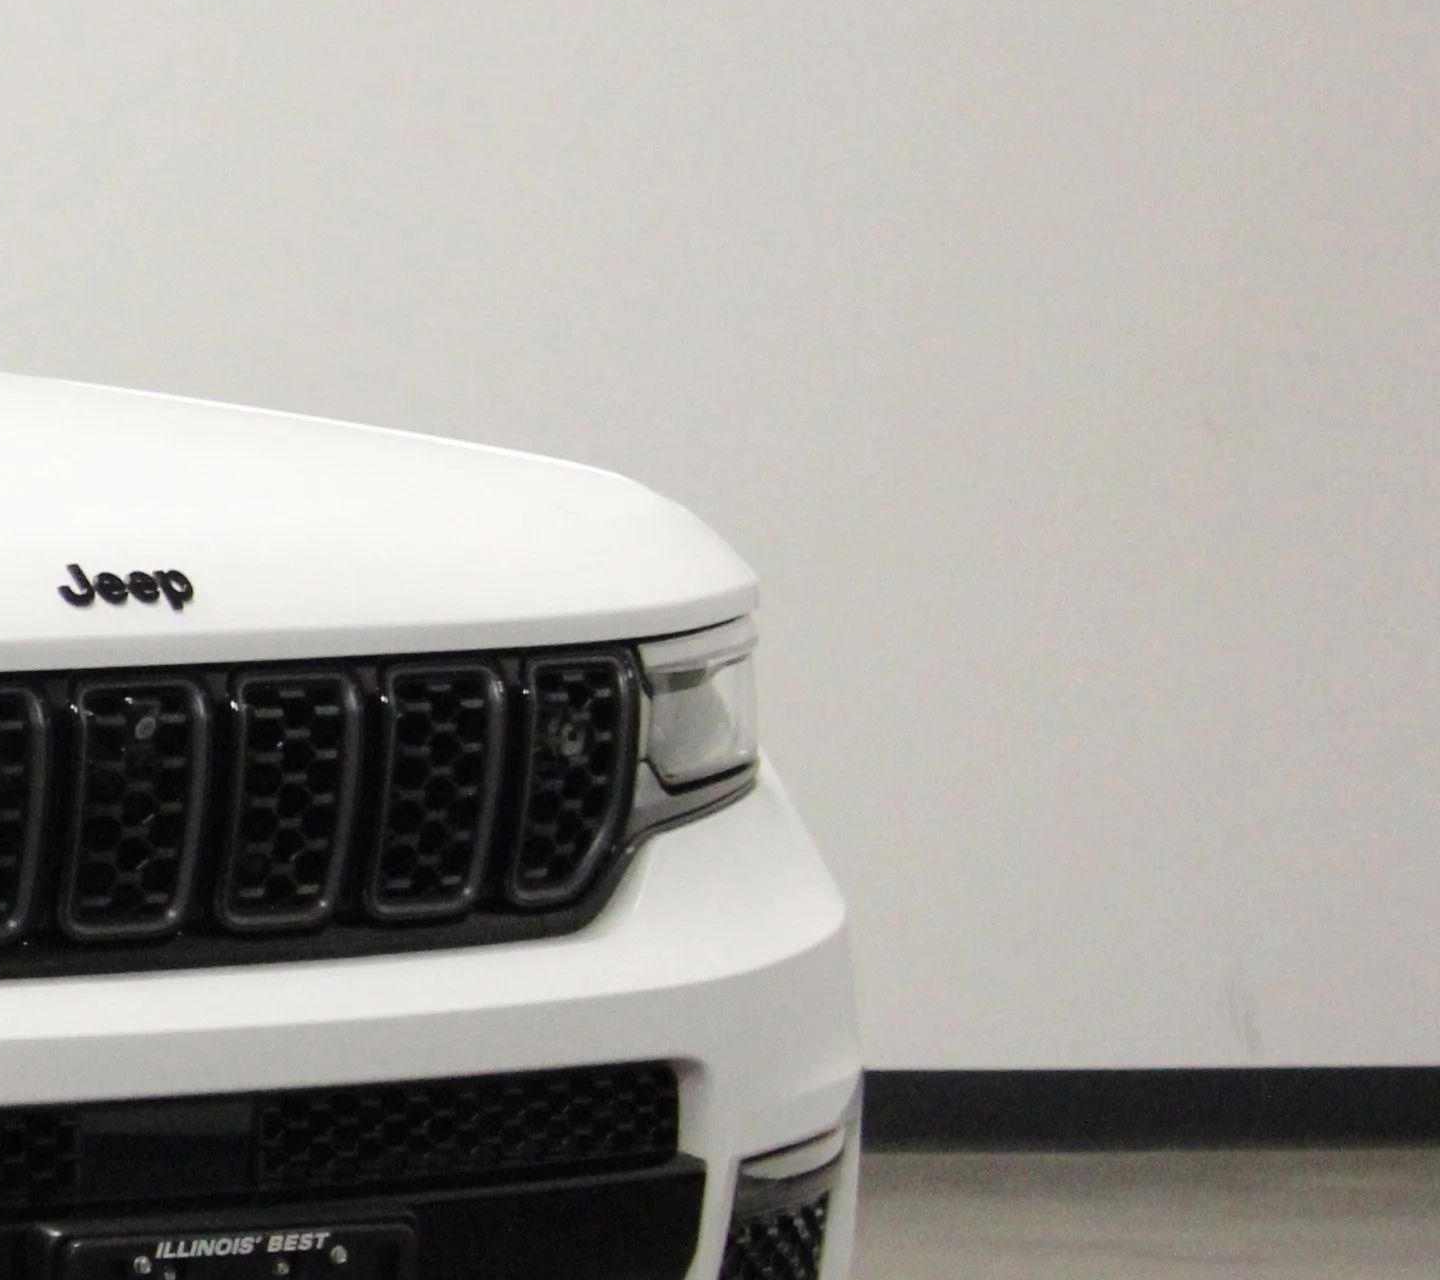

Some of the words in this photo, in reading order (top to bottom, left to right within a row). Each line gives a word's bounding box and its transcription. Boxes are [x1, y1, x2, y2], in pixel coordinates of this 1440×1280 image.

[58, 563, 194, 614] Jeep
[155, 1235, 261, 1259] ILLINOIS'
[266, 1231, 330, 1254] BEST
